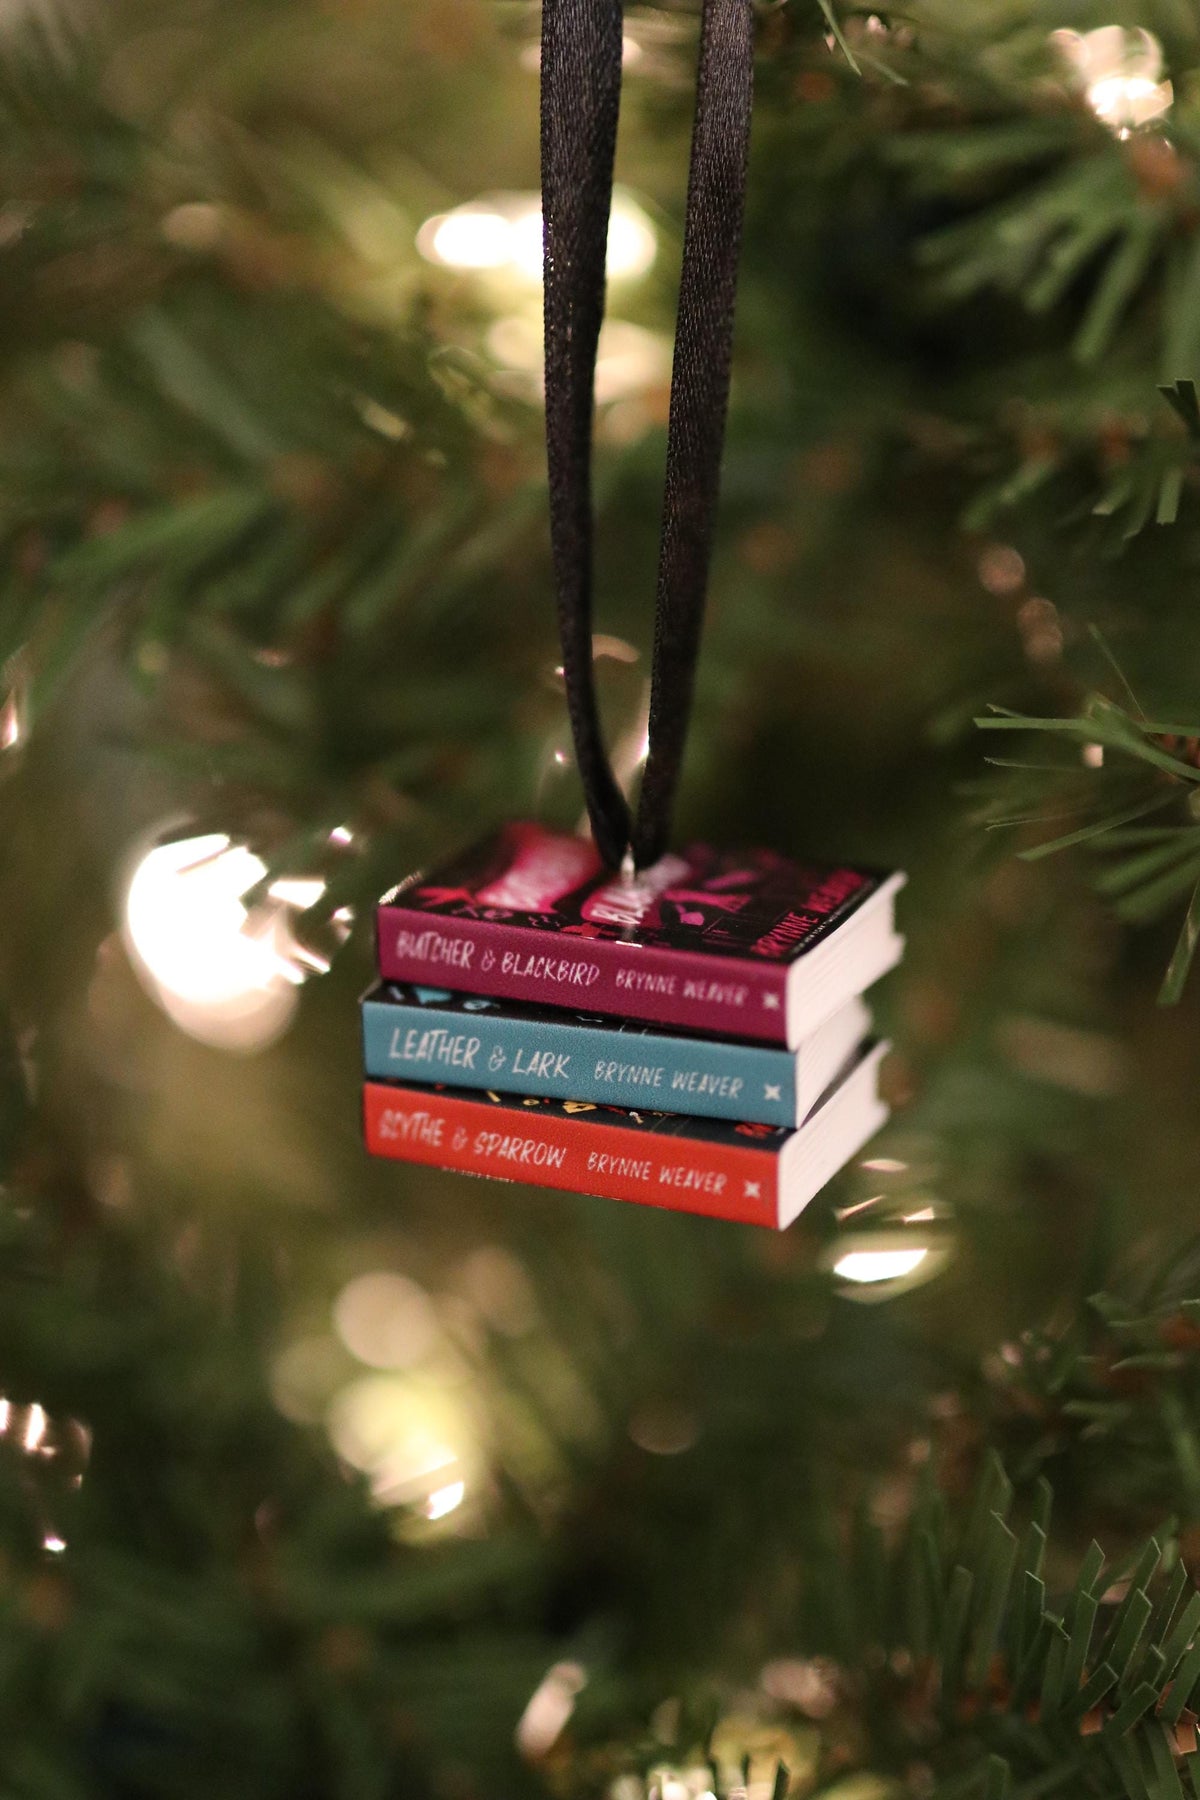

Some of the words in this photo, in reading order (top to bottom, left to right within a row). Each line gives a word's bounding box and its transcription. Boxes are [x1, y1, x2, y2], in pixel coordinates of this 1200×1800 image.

[397, 930, 474, 970] BUTCHER
[481, 950, 497, 972] &
[501, 951, 600, 986] BLACKBIRD
[616, 969, 676, 996] BRYNNE
[389, 1028, 481, 1070] LEATHER
[488, 1046, 506, 1072] &
[512, 1049, 571, 1079] LARK
[594, 1060, 664, 1087] BRYNNE
[671, 1070, 744, 1098] WEAVER
[473, 1131, 566, 1168] SPARROW
[587, 1152, 652, 1180] BRYNNE
[659, 1166, 727, 1195] WEAVER
